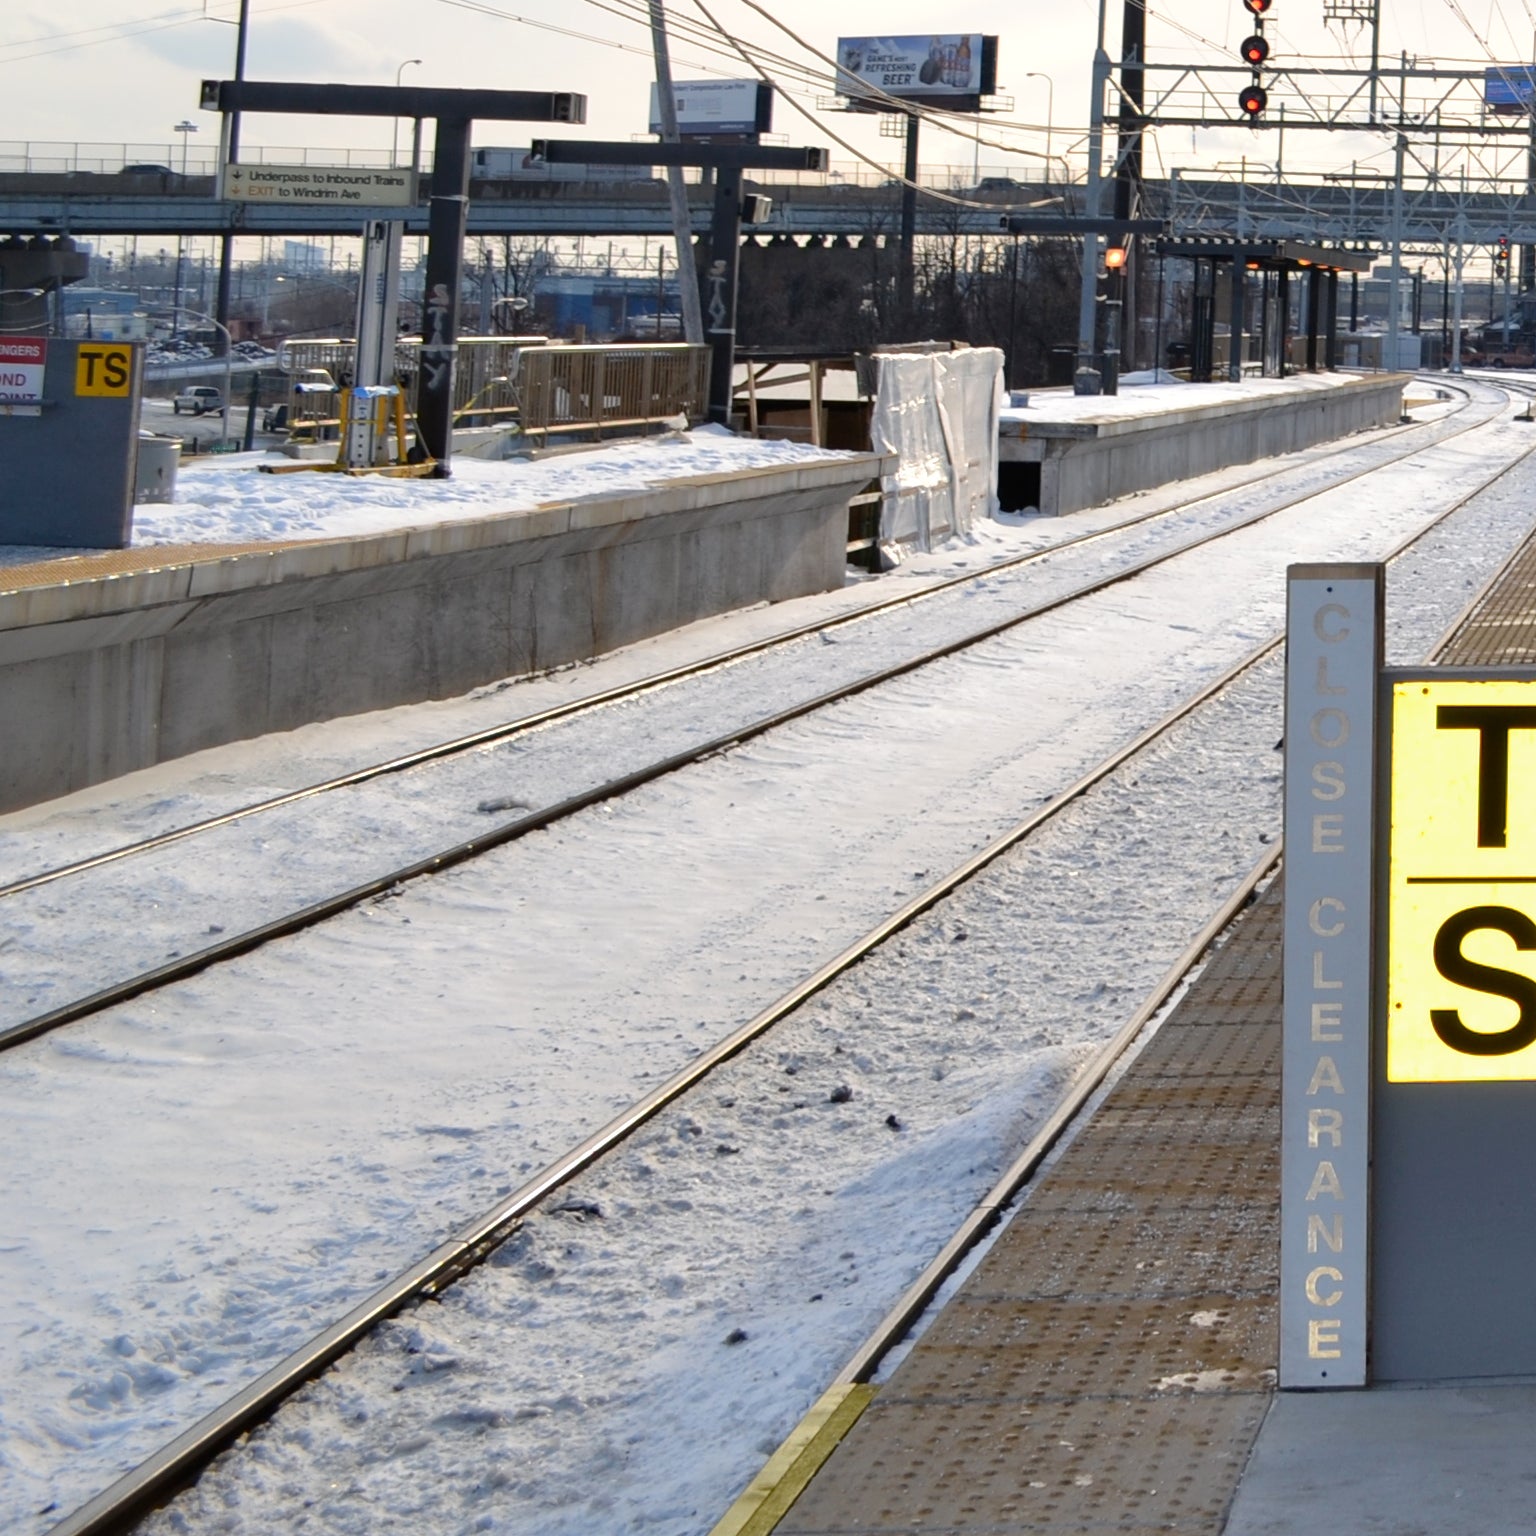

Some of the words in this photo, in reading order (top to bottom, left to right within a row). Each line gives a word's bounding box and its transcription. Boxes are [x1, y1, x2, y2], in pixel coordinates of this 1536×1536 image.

[865, 63, 917, 73] REFRESHING
[882, 74, 912, 86] BEER
[249, 171, 310, 183] Underpass
[313, 172, 325, 183] to
[327, 173, 371, 185] Inbound
[373, 175, 405, 186] Trains
[248, 186, 275, 196] EXIT
[279, 187, 290, 197] to
[293, 188, 338, 199] Windrim
[341, 189, 361, 200] Ave
[425, 283, 450, 390] STAY
[81, 352, 128, 388] TS
[1310, 603, 1351, 853] CLOSE
[1305, 897, 1347, 1358] CLEARANCE
